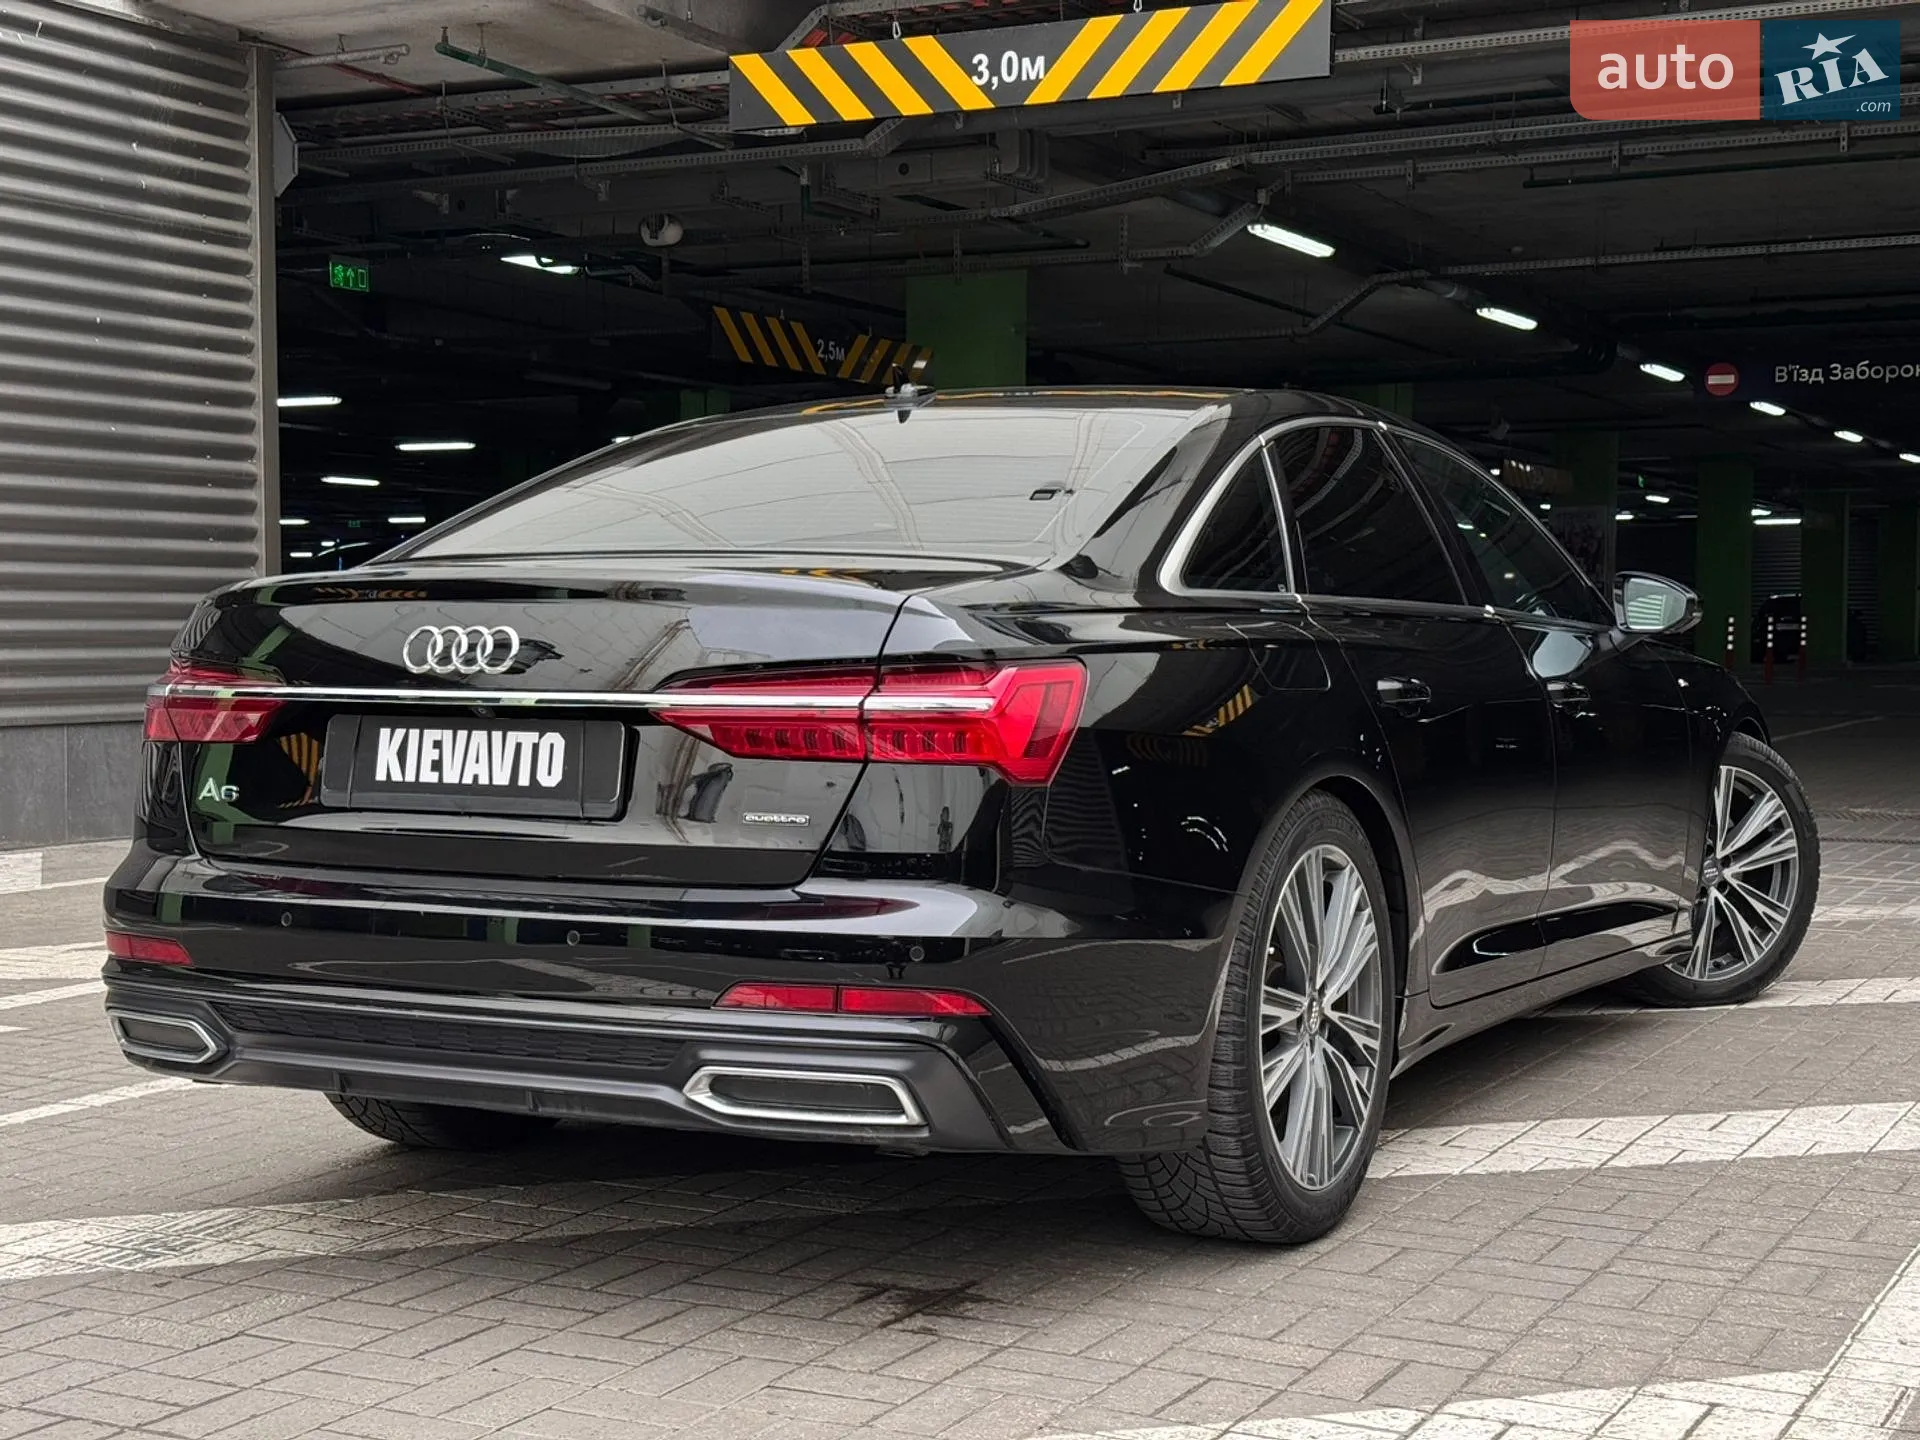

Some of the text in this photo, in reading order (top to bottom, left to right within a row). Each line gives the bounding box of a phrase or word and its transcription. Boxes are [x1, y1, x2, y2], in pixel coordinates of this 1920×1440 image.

[1774, 364, 1825, 384] В'їзд
[375, 727, 566, 788] KIEVAVTO
[198, 777, 239, 802] A6
[744, 814, 807, 824] quattro
